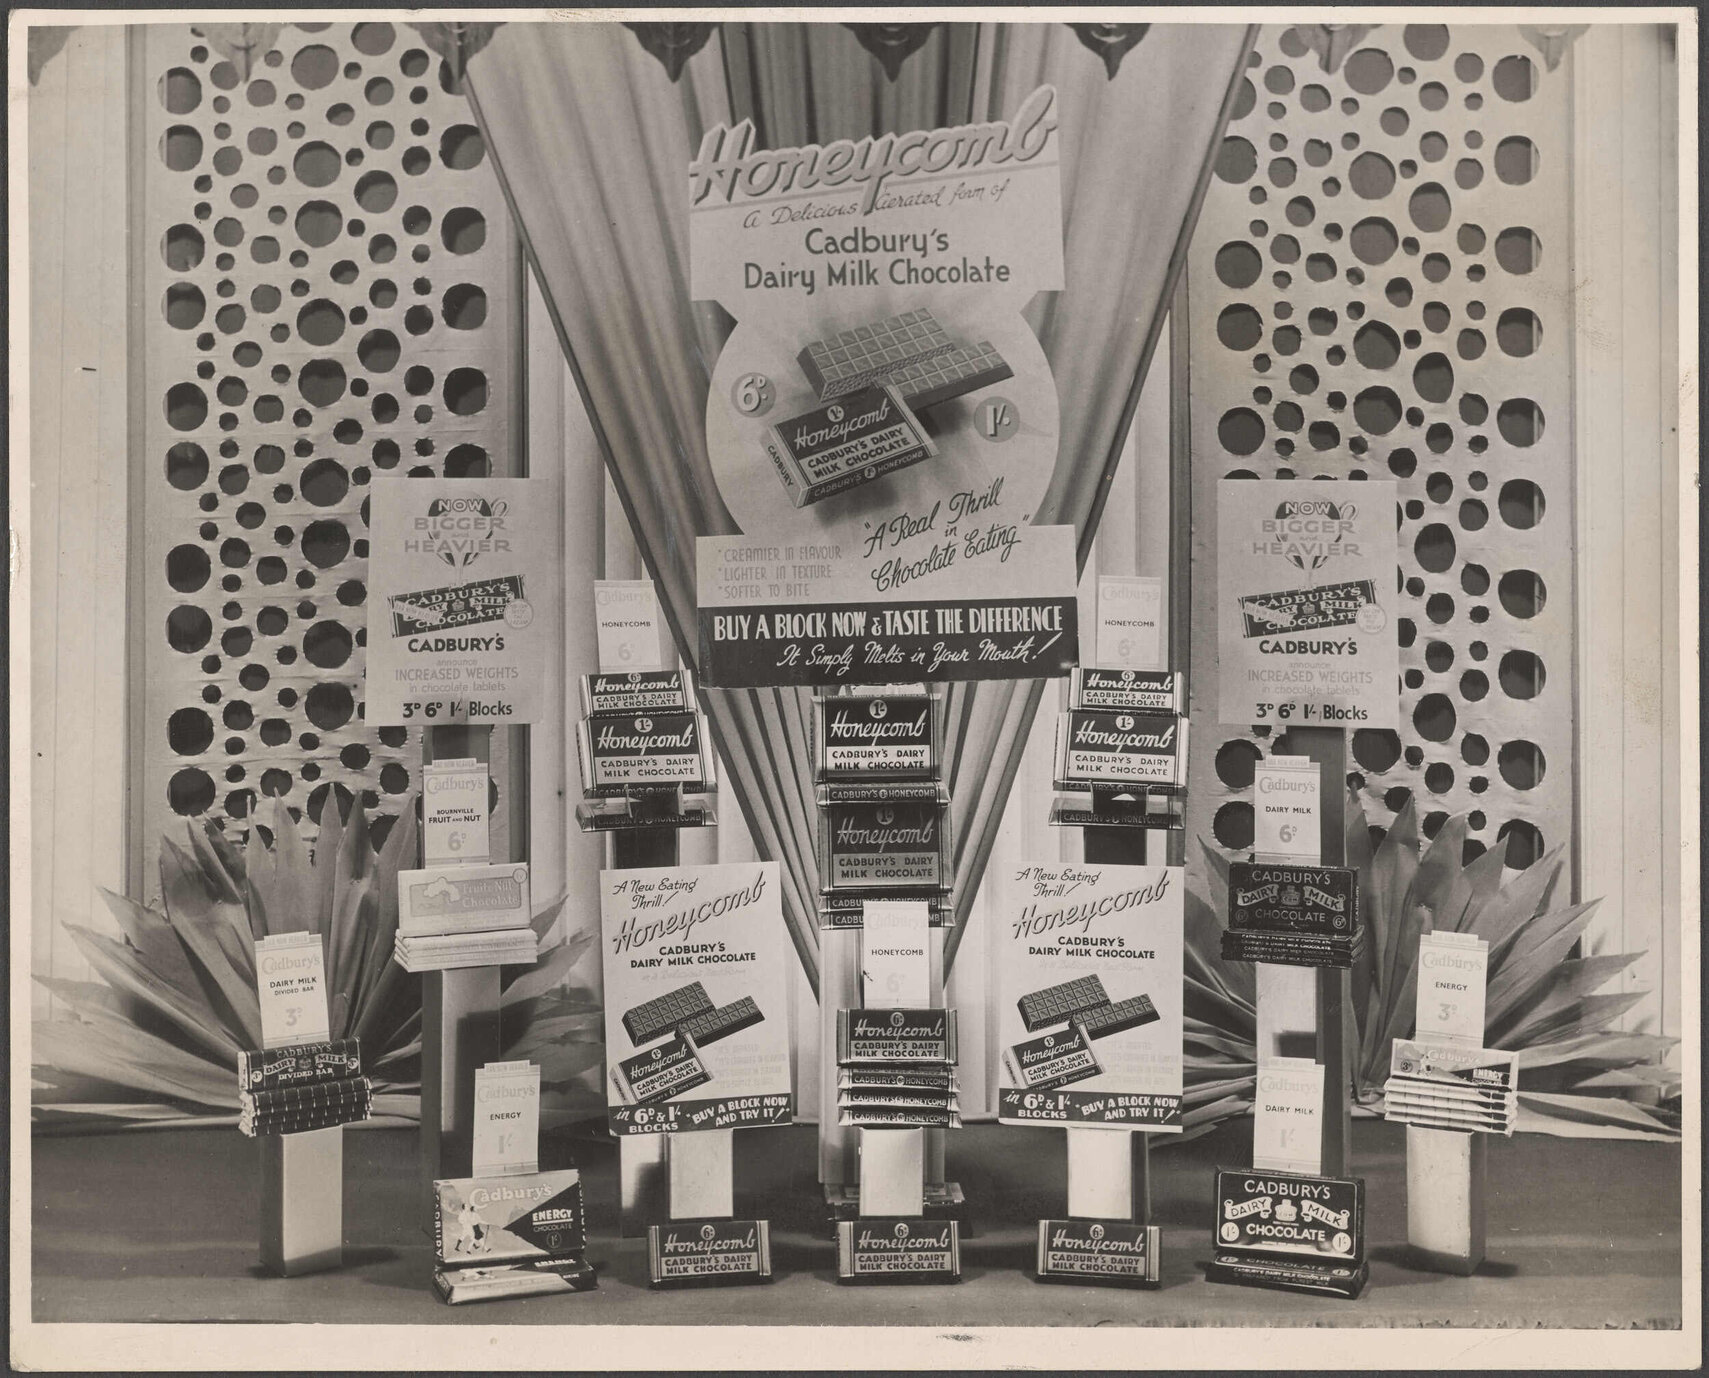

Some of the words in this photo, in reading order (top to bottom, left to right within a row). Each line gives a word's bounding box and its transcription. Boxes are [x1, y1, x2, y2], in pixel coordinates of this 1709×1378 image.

[689, 84, 1058, 216] Honeycomb
[771, 202, 857, 226] Delicious
[949, 182, 985, 205] form
[990, 178, 1010, 201] of
[805, 227, 949, 257] Cadbury's
[744, 262, 815, 295] Dairy
[827, 260, 879, 286] Milk
[888, 256, 1010, 284] Chocolate
[794, 397, 891, 450] Honeycomb
[807, 438, 868, 468] CADBURY'S
[871, 427, 904, 446] DAIRY
[767, 445, 794, 487] CADBURY
[813, 463, 841, 479] MILK
[846, 438, 911, 467] CHOCOLATE
[438, 499, 484, 513] NOW
[890, 501, 941, 547] Real
[949, 477, 1004, 523] Thrill
[1285, 502, 1332, 515] NOW
[414, 517, 508, 530] BIGGER
[945, 520, 957, 538] in
[1262, 520, 1356, 533] BIGGER
[404, 539, 513, 553] HEAVIER
[724, 548, 780, 562] CREAMIER
[785, 547, 794, 560] IN
[800, 546, 842, 560] FLAVOUR
[1253, 542, 1362, 556] HEAVIER
[724, 566, 767, 581] LIGHTER
[776, 565, 786, 579] IN
[792, 564, 832, 579] TEXTURE
[872, 543, 957, 592] Chocolate
[405, 581, 511, 606] CADBURY'S
[724, 585, 762, 599] SOFTER
[768, 584, 780, 597] TO
[786, 583, 810, 597] BITE
[714, 615, 751, 641] BUY
[755, 614, 771, 640] A
[775, 612, 827, 639] BLOCK
[832, 611, 867, 637] NOW
[872, 616, 882, 636] &
[883, 610, 930, 636] TASTE
[935, 608, 964, 634] THE
[969, 606, 1063, 633] DIFFERENCE
[1105, 620, 1155, 628] HONEYCOMB
[408, 633, 505, 652] CADBURY'S
[1259, 637, 1357, 655] CADBURY'S
[776, 643, 801, 667] It
[805, 644, 853, 676] Simply
[864, 641, 904, 666] Melts
[910, 647, 925, 664] in
[928, 641, 970, 673] Your
[978, 632, 1063, 664] Mouth!
[396, 669, 461, 681] INCREASED
[466, 667, 519, 680] WEIGHTS
[1248, 670, 1313, 682] INCREASED
[1319, 671, 1373, 684] WEIGHTS
[421, 682, 468, 692] chocolate
[473, 681, 506, 691] tablets
[469, 700, 512, 716] Blocks
[1323, 704, 1368, 720] Blocks
[830, 709, 928, 746] Honeycomb
[598, 723, 693, 755] Honeycomb
[832, 749, 888, 759] CADBURY'S
[897, 749, 925, 758] DAIRY
[601, 757, 658, 768] CADBURY'S
[666, 757, 694, 766] DAIRY
[835, 761, 860, 770] MILK
[867, 761, 925, 770] CHOCOLATE
[604, 769, 630, 777] MILK
[638, 768, 695, 776] CHOCOLATE
[426, 776, 484, 794] Cadbury's
[1259, 776, 1316, 794] Cadbury's
[832, 789, 878, 799] CADBURY'S
[888, 789, 936, 798] HONEYCOMB
[1252, 870, 1331, 885] CADBURY'S
[612, 880, 628, 895] A
[630, 879, 654, 892] New
[658, 877, 699, 893] Eating
[1012, 869, 1170, 940] Honeycomb
[1242, 886, 1275, 904] DAIRY
[1309, 889, 1340, 910] MILK
[612, 870, 766, 955] Honeycomb
[1255, 909, 1326, 922] CHOCOLATE
[659, 941, 726, 956] CADBURY'S
[1058, 936, 1125, 947] CADBURY'S
[630, 958, 664, 968] DAIRY
[668, 956, 693, 965] MILK
[697, 952, 756, 964] CHOCOLATE
[1029, 947, 1061, 956] DAIRY
[1066, 948, 1091, 957] MILK
[1095, 949, 1155, 959] CHOCOLATE
[262, 954, 320, 975] Cadbury's
[1422, 952, 1483, 972] Cadbury's
[269, 979, 294, 988] DAIRY
[1435, 981, 1468, 991] ENERGY
[854, 1018, 944, 1040] Honeycomb
[276, 1044, 332, 1058] CADBURY'S
[854, 1041, 909, 1050] CADBURY'S
[912, 1042, 939, 1050] DAIRY
[266, 1059, 295, 1074] DAIRY
[319, 1055, 345, 1063] MILK
[279, 1071, 313, 1080] DIVIDED
[316, 1068, 333, 1076] BAR
[718, 1103, 726, 1114] A
[727, 1098, 761, 1112] BLOCK
[763, 1096, 788, 1107] NOW
[1265, 1105, 1290, 1113] DAIRY
[1295, 1107, 1314, 1115] MILK
[490, 1112, 521, 1120] ENERGY
[614, 1107, 630, 1121] in
[657, 1111, 666, 1121] &
[715, 1113, 737, 1126] AND
[741, 1109, 760, 1121] TRY
[629, 1122, 679, 1134] BLOCKS
[470, 1184, 552, 1209] Cadbury's
[1244, 1180, 1331, 1200] CADBURY'S
[532, 1209, 572, 1222] ENERGY
[1231, 1199, 1267, 1217] DAIRY
[1308, 1204, 1341, 1226] MILK
[533, 1223, 572, 1232] CHOCOLATE
[1246, 1223, 1325, 1241] CHOCOLATE
[664, 1228, 756, 1255] Honeycomb
[1052, 1229, 1145, 1254] Honeycomb
[665, 1255, 719, 1266] CADBURY'S
[724, 1255, 752, 1263] DAIRY
[1052, 1254, 1106, 1263] CADBURY'S
[1111, 1257, 1140, 1265] DAIRY
[694, 1263, 752, 1273] CHOCOLATE
[1052, 1262, 1075, 1270] MILK
[1080, 1263, 1138, 1274] CHOCOLATE
